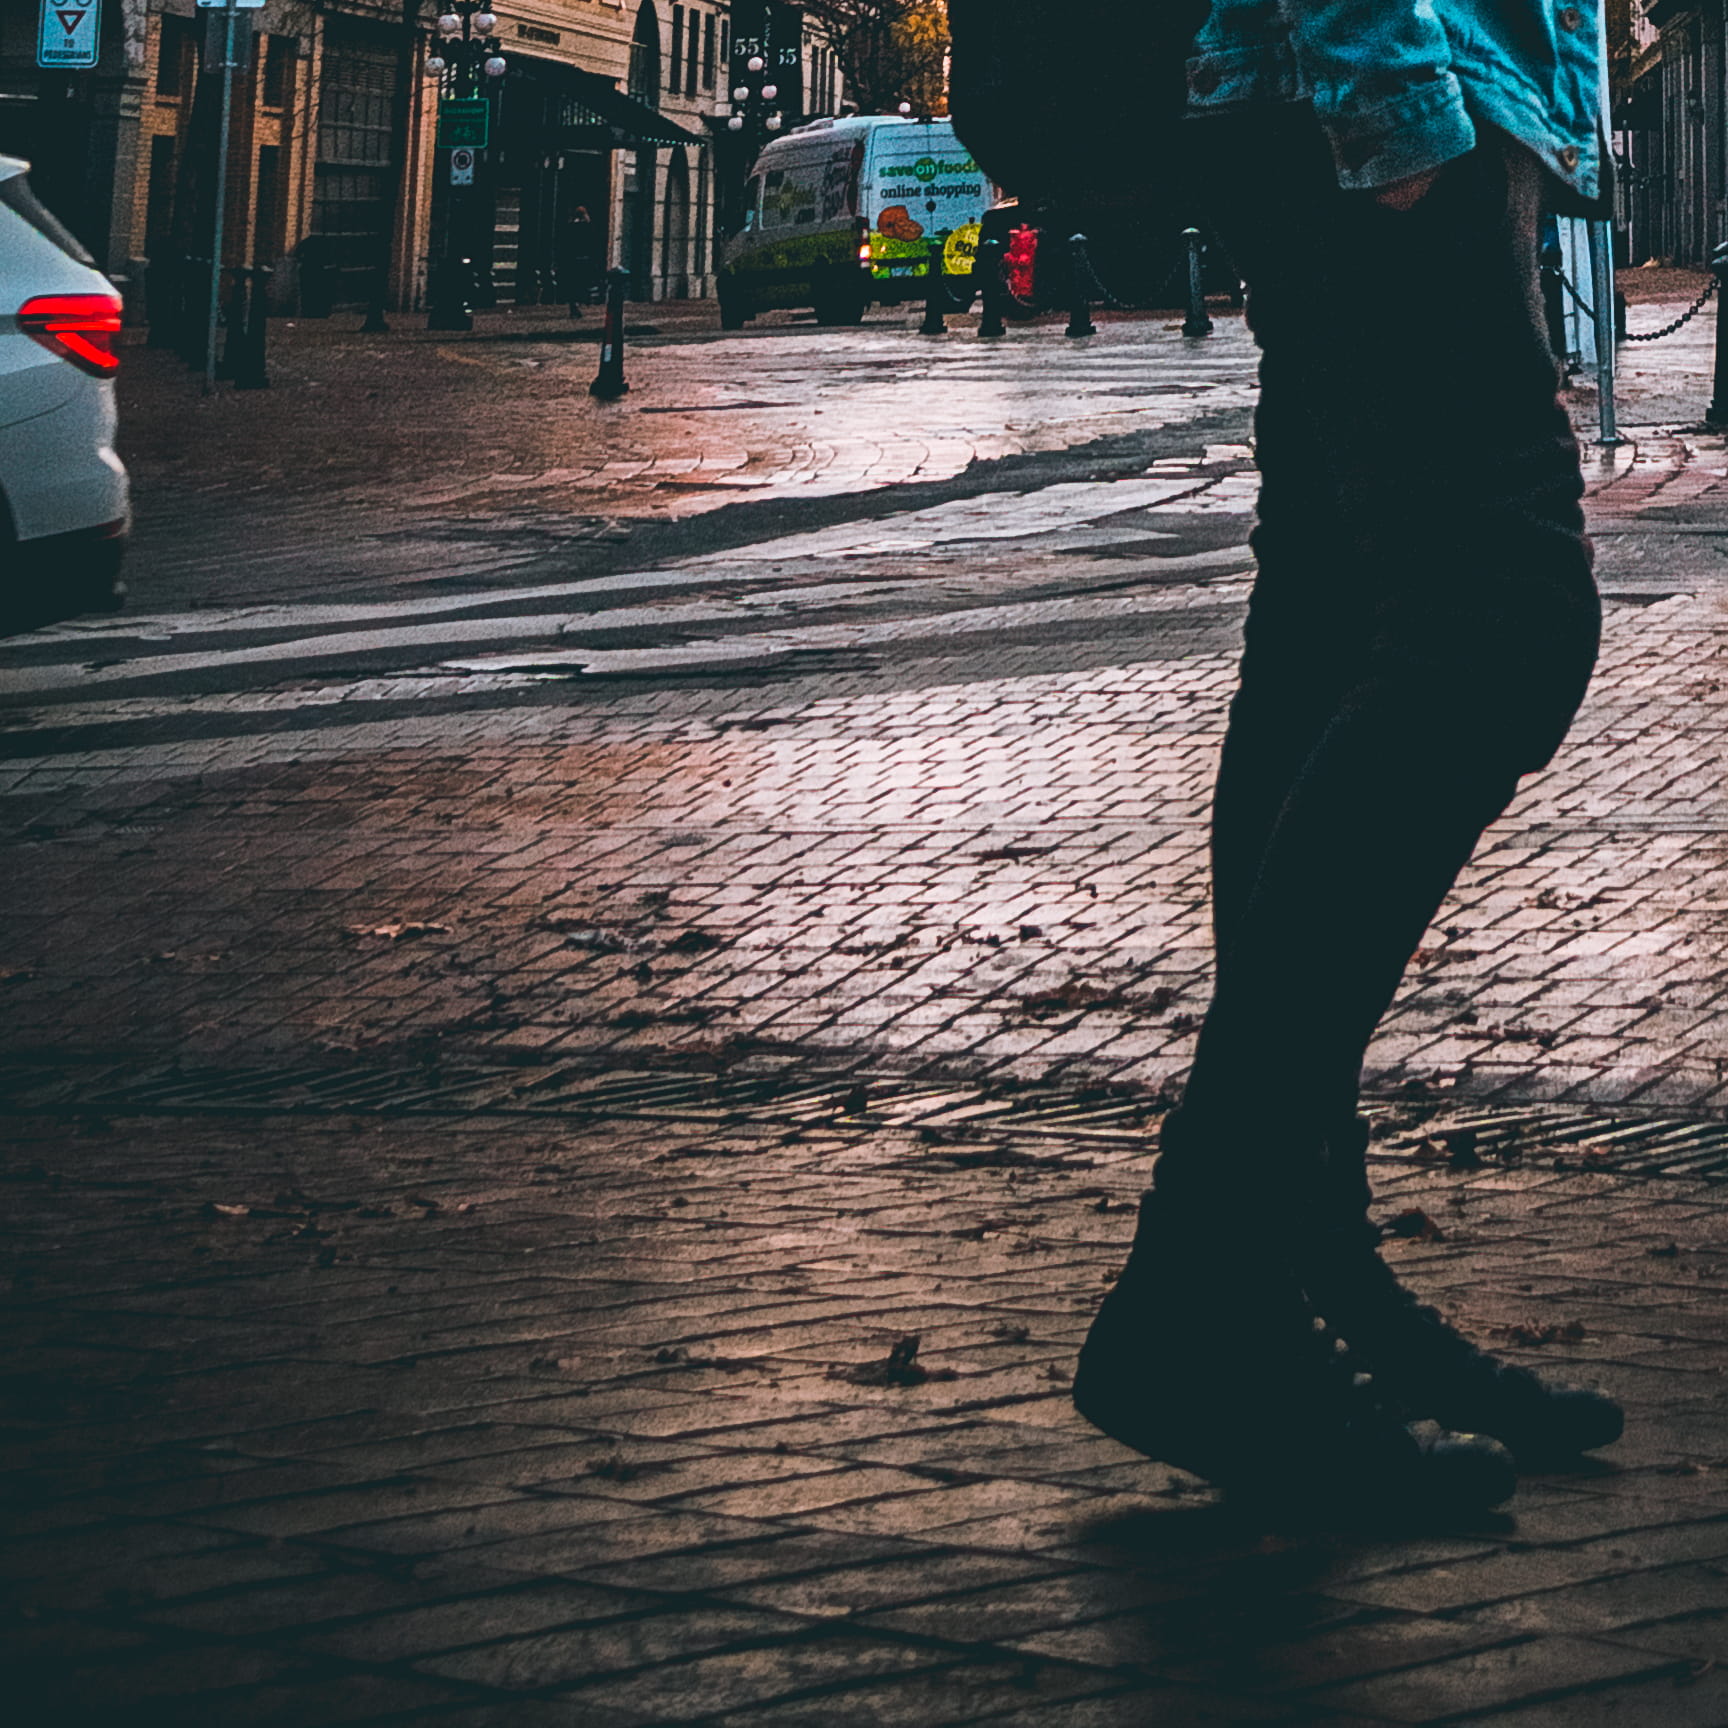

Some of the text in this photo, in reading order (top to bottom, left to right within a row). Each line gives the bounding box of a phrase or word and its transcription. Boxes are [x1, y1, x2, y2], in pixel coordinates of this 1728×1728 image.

[734, 37, 760, 55] 55
[880, 181, 982, 199] online shopping
